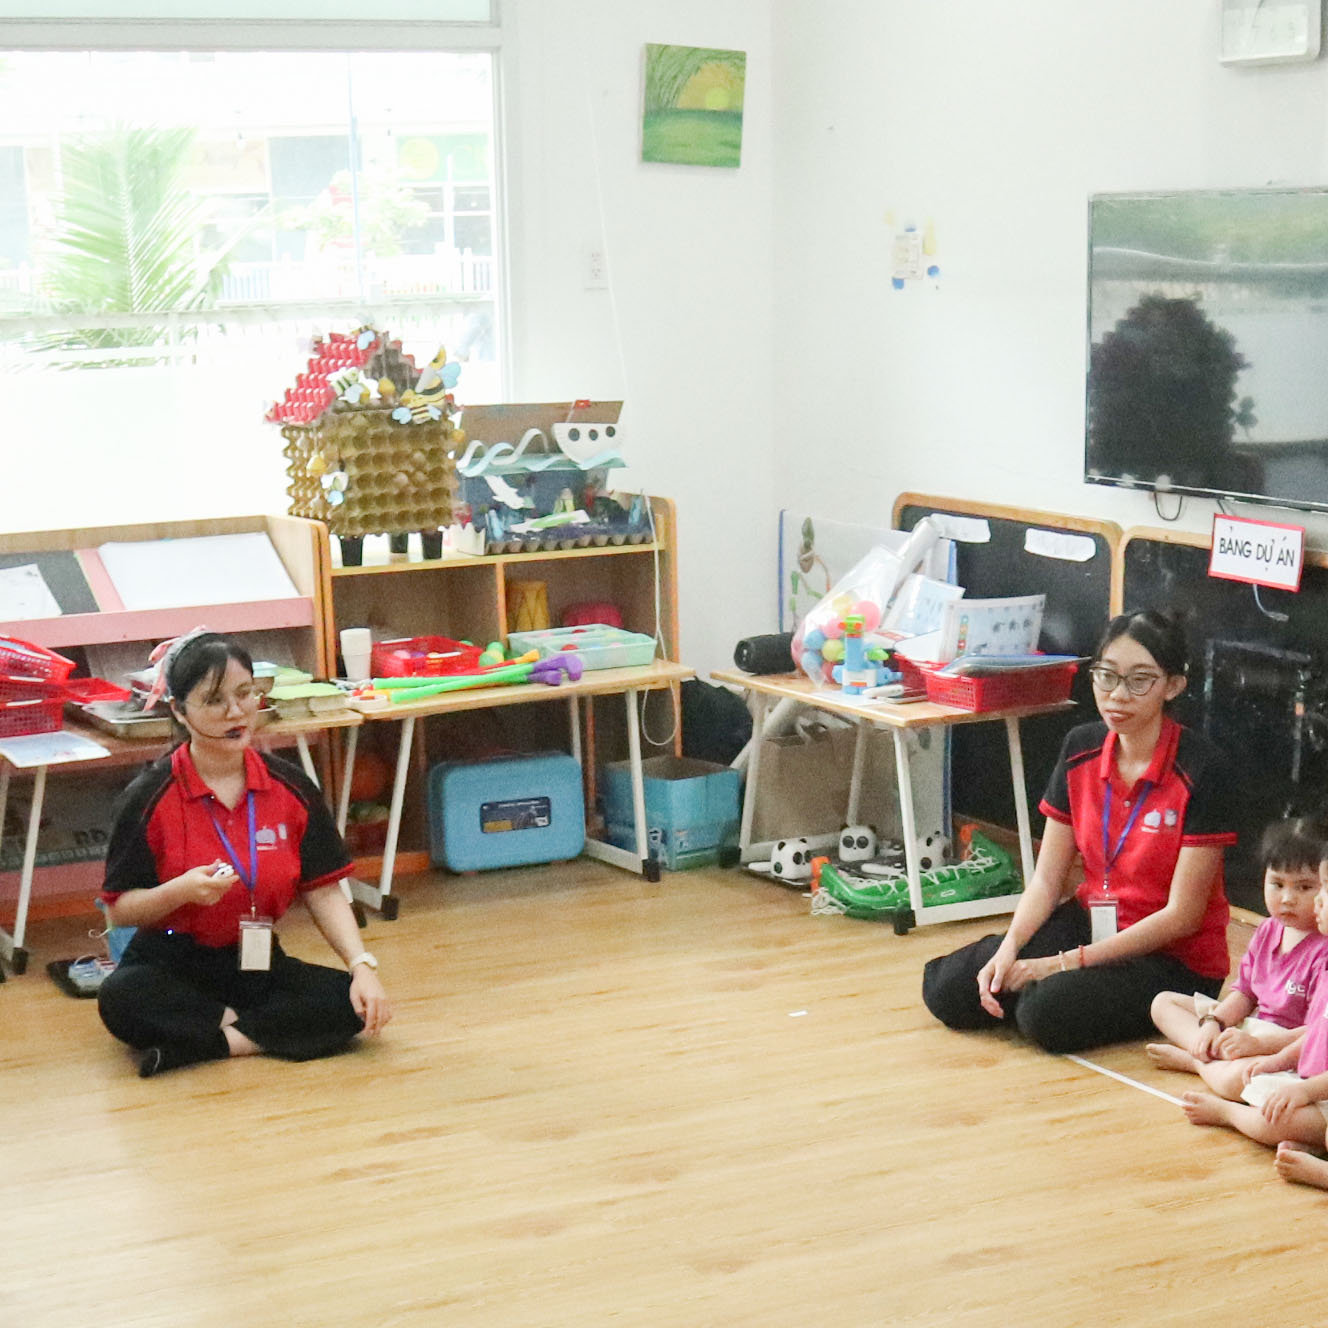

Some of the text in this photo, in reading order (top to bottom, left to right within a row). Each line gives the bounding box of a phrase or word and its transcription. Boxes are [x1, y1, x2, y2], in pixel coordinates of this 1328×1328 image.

[1219, 526, 1295, 572] BẢNG DỰ ÁN
